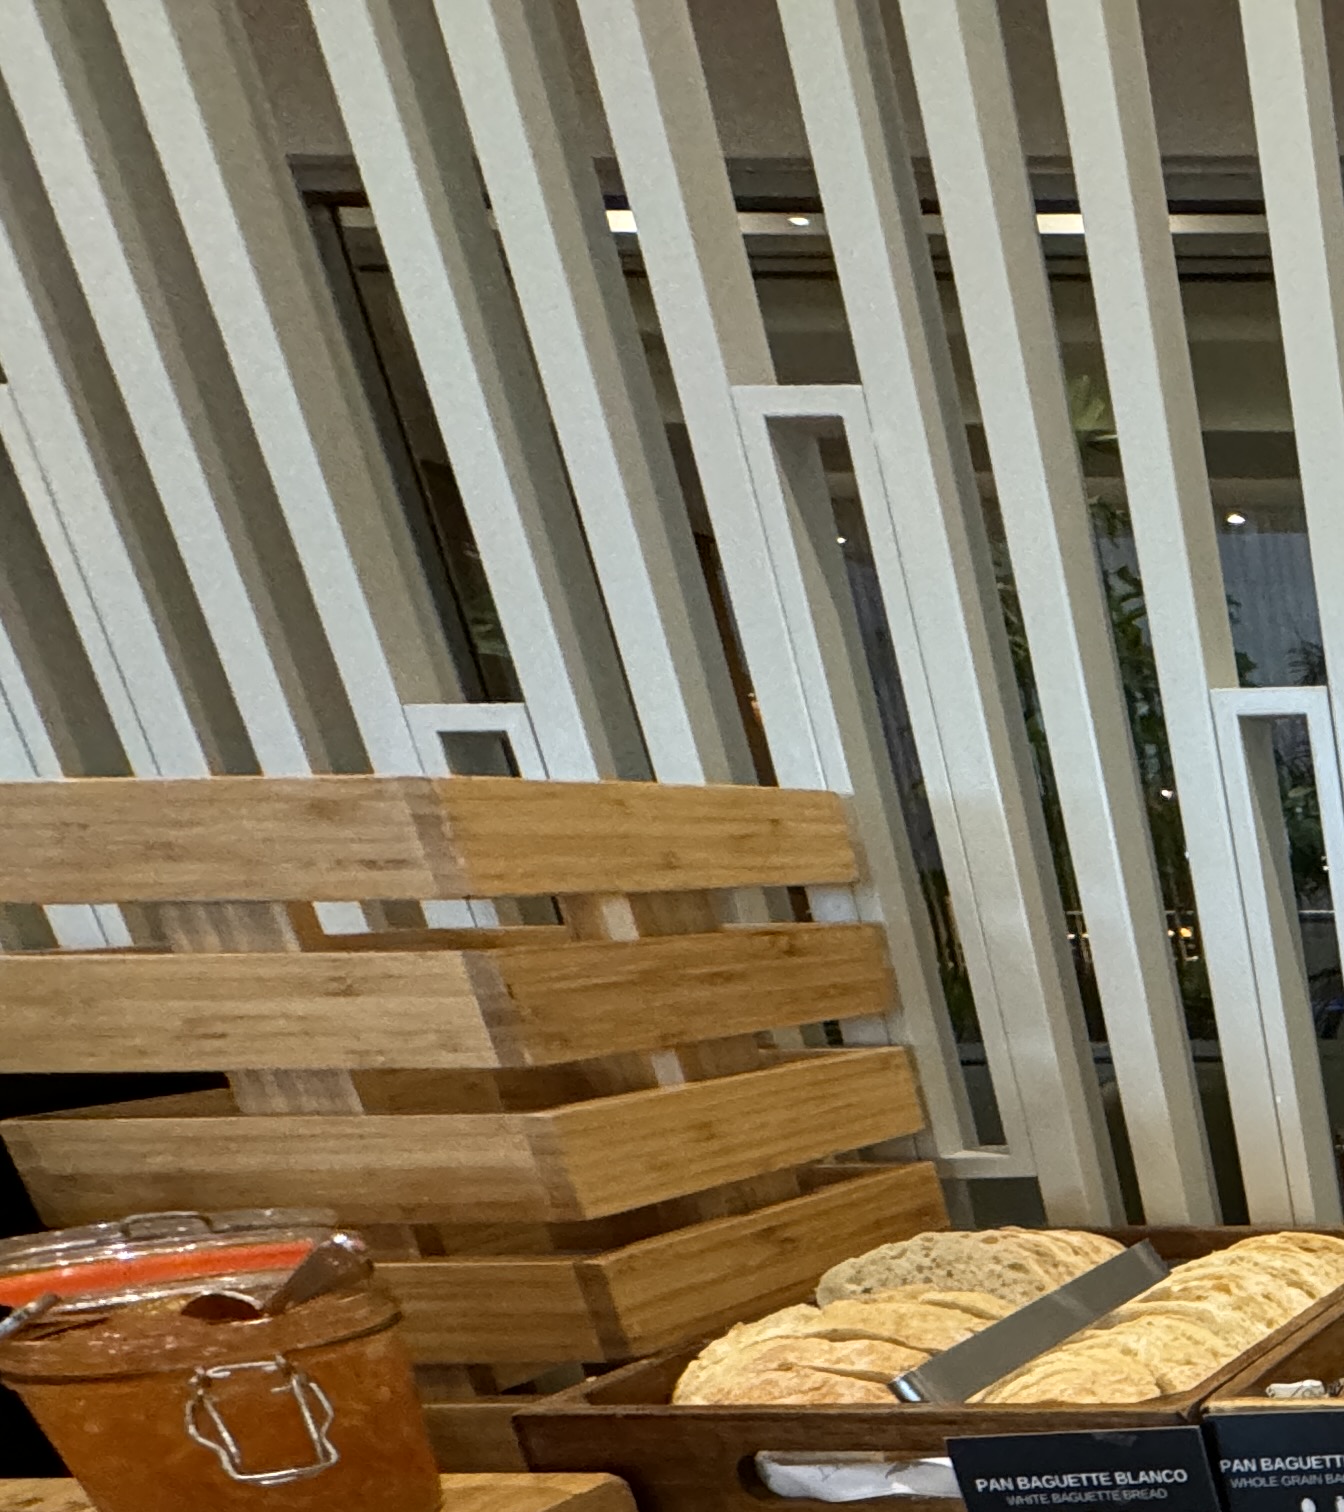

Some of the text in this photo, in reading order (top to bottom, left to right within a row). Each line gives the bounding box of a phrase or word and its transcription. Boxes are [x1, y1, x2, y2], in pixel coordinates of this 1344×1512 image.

[1219, 1458, 1257, 1473] PAN
[975, 1468, 1188, 1492] PAN BAGUETTE BLANCO
[1230, 1475, 1279, 1489] WHOLE
[1280, 1473, 1323, 1487] GRAIN
[1006, 1487, 1168, 1506] WHITE BAGUETTE BREAD
